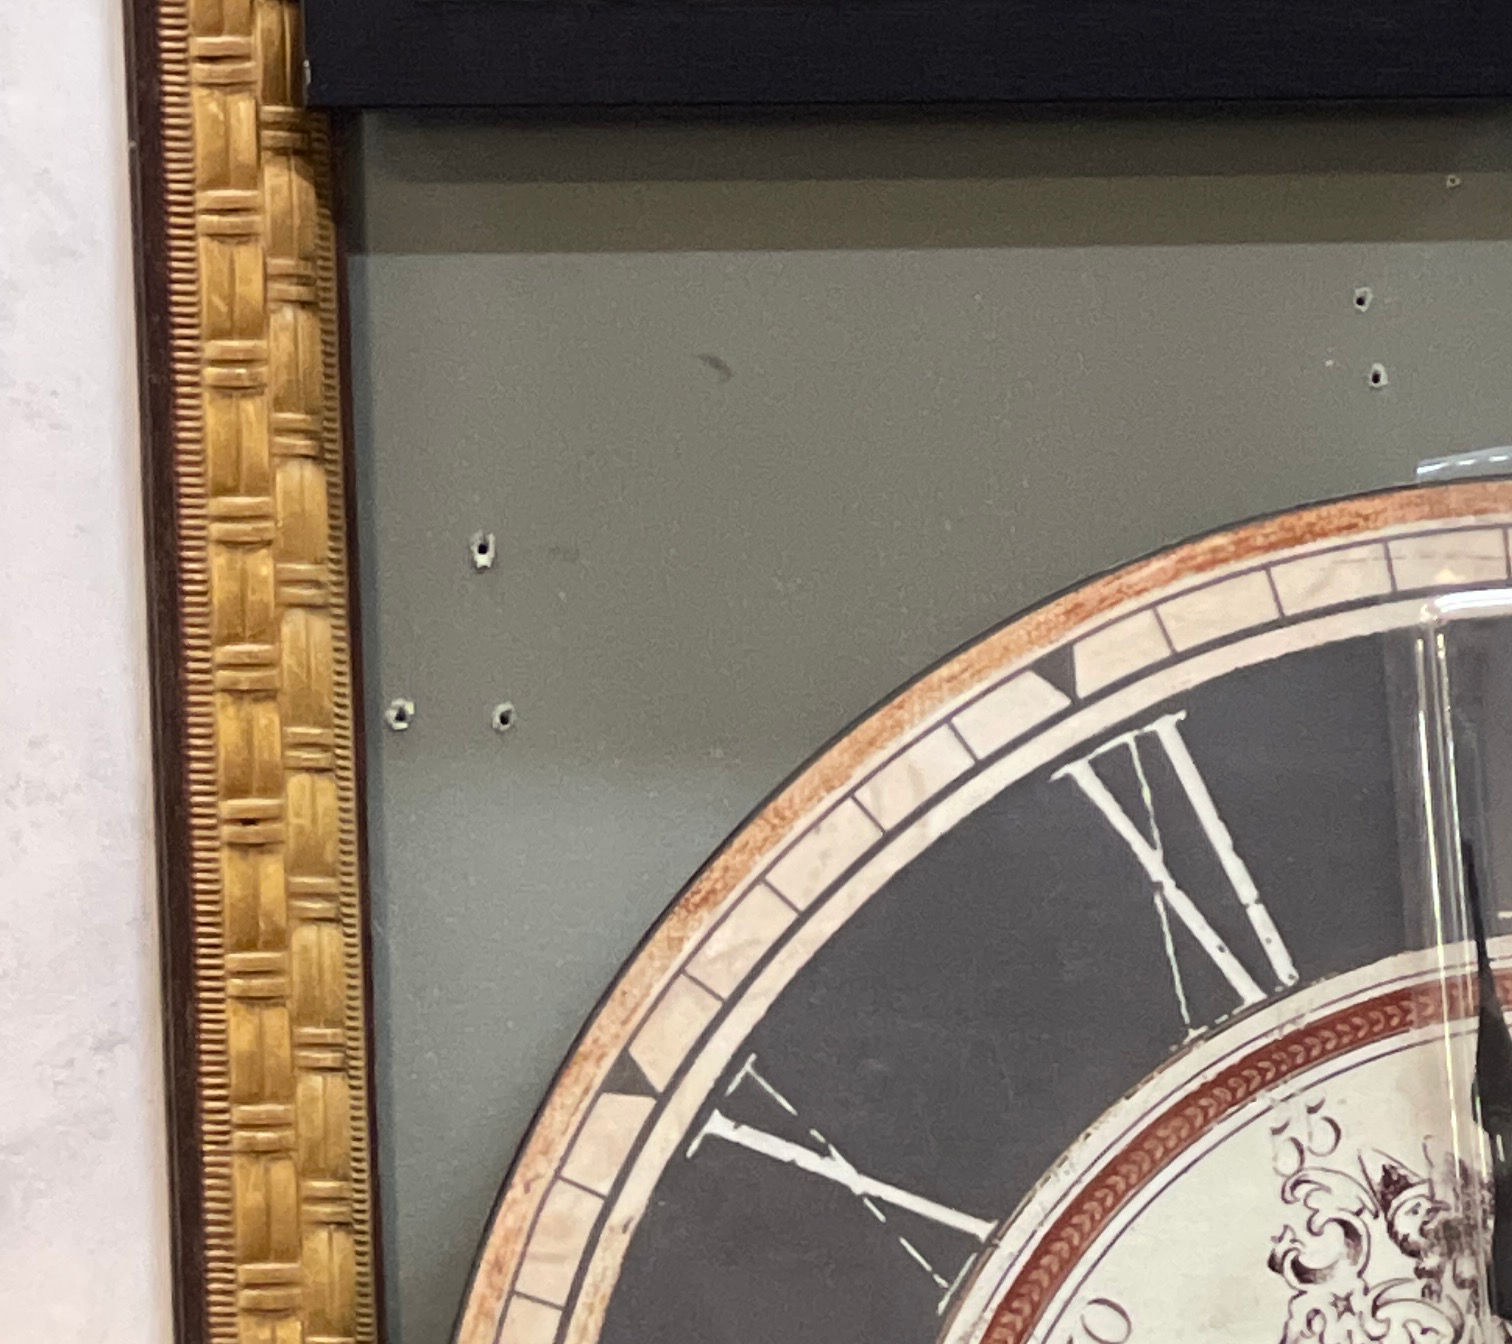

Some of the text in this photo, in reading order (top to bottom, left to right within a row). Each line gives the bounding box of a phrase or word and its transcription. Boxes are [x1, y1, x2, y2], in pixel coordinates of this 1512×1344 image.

[1050, 710, 1298, 1051] XI
[686, 1053, 1000, 1315] X
[1270, 1097, 1341, 1177] 55
